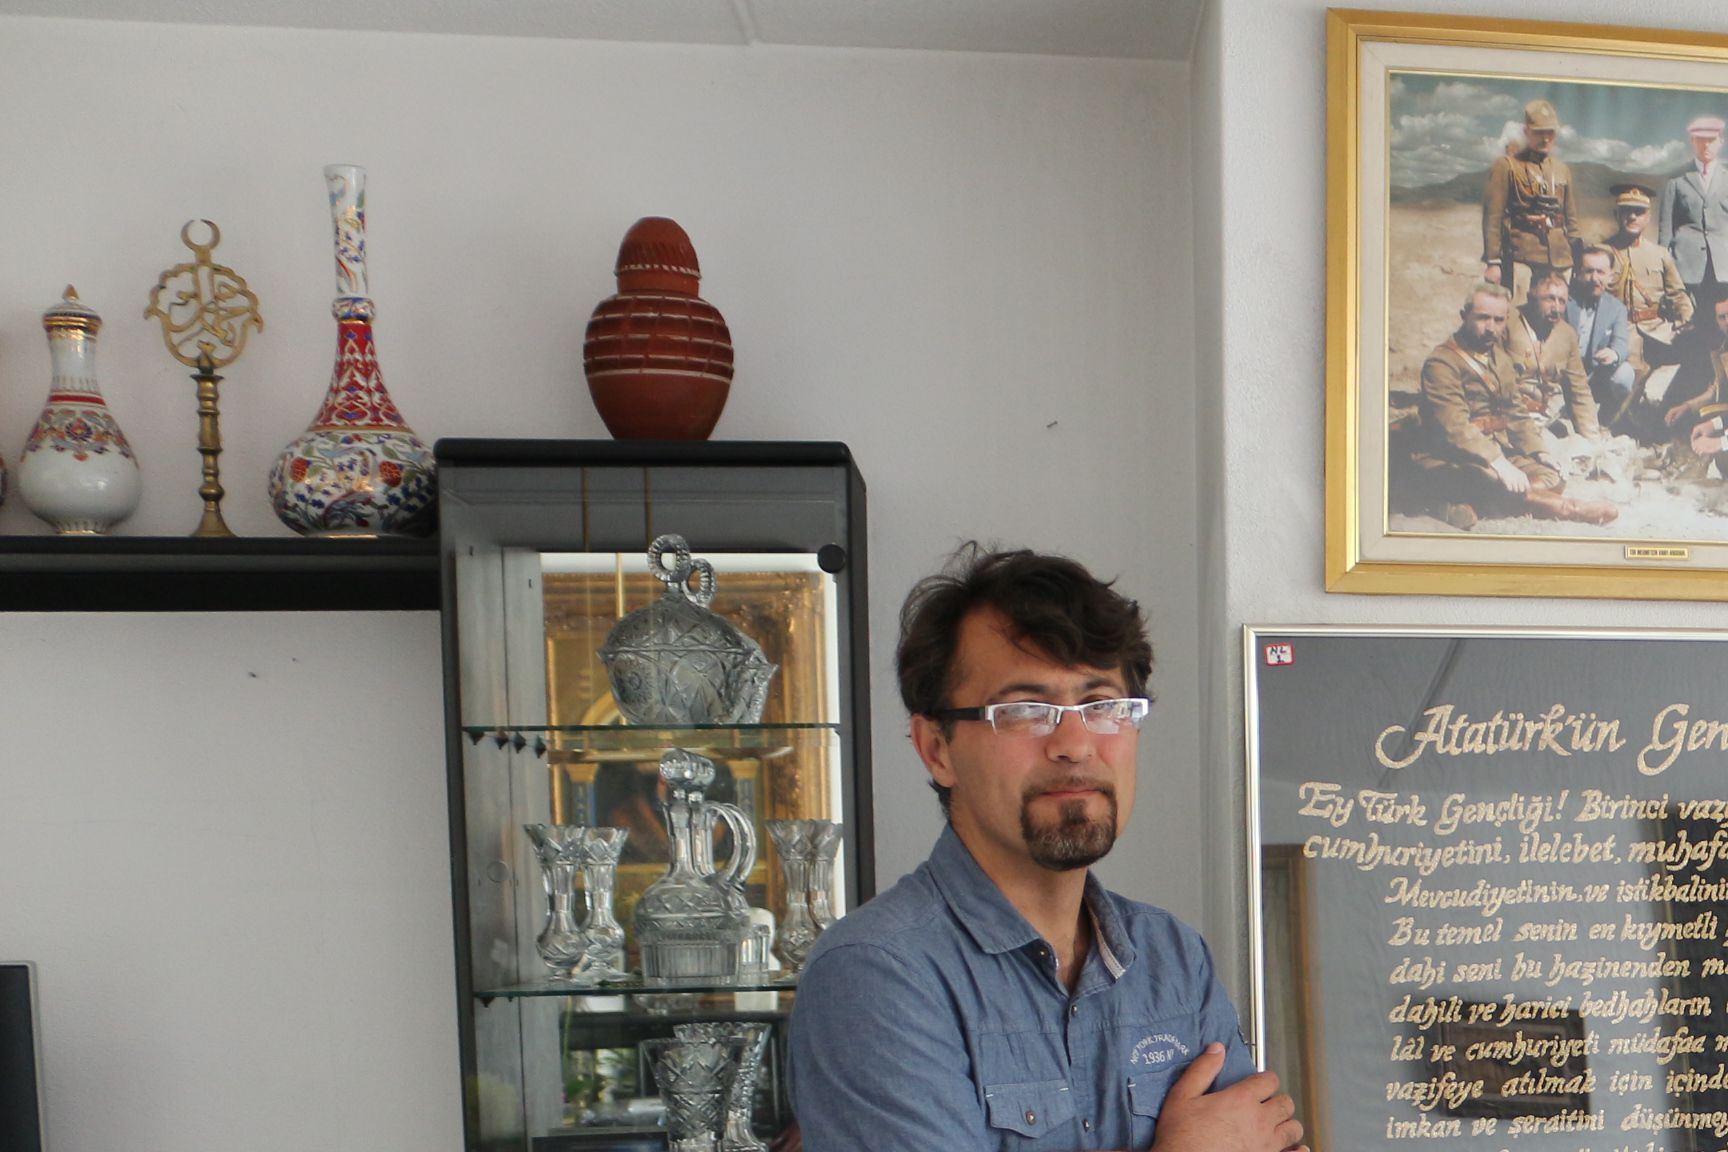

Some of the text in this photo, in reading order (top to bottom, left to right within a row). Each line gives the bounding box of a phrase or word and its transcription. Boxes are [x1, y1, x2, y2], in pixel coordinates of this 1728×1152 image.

[1298, 782, 1354, 828] Ey
[1358, 790, 1427, 826] Türk
[1575, 790, 1668, 821] Birinci
[1585, 884, 1609, 902] ve
[1388, 917, 1616, 945] Bu temel senin en
[1390, 956, 1446, 990] dahi
[1453, 958, 1502, 982] seni
[1511, 952, 1541, 981] bu
[1500, 994, 1572, 1028] harici
[1142, 1050, 1166, 1065] 1936
[1391, 1035, 1425, 1061] lâl
[1430, 1044, 1456, 1063] ve
[1608, 1026, 1707, 1065] müdafaa
[1387, 1071, 1484, 1112] vazifeye
[1610, 1071, 1652, 1095] için
[1387, 1113, 1461, 1138] imkan
[1472, 1117, 1497, 1136] ve
